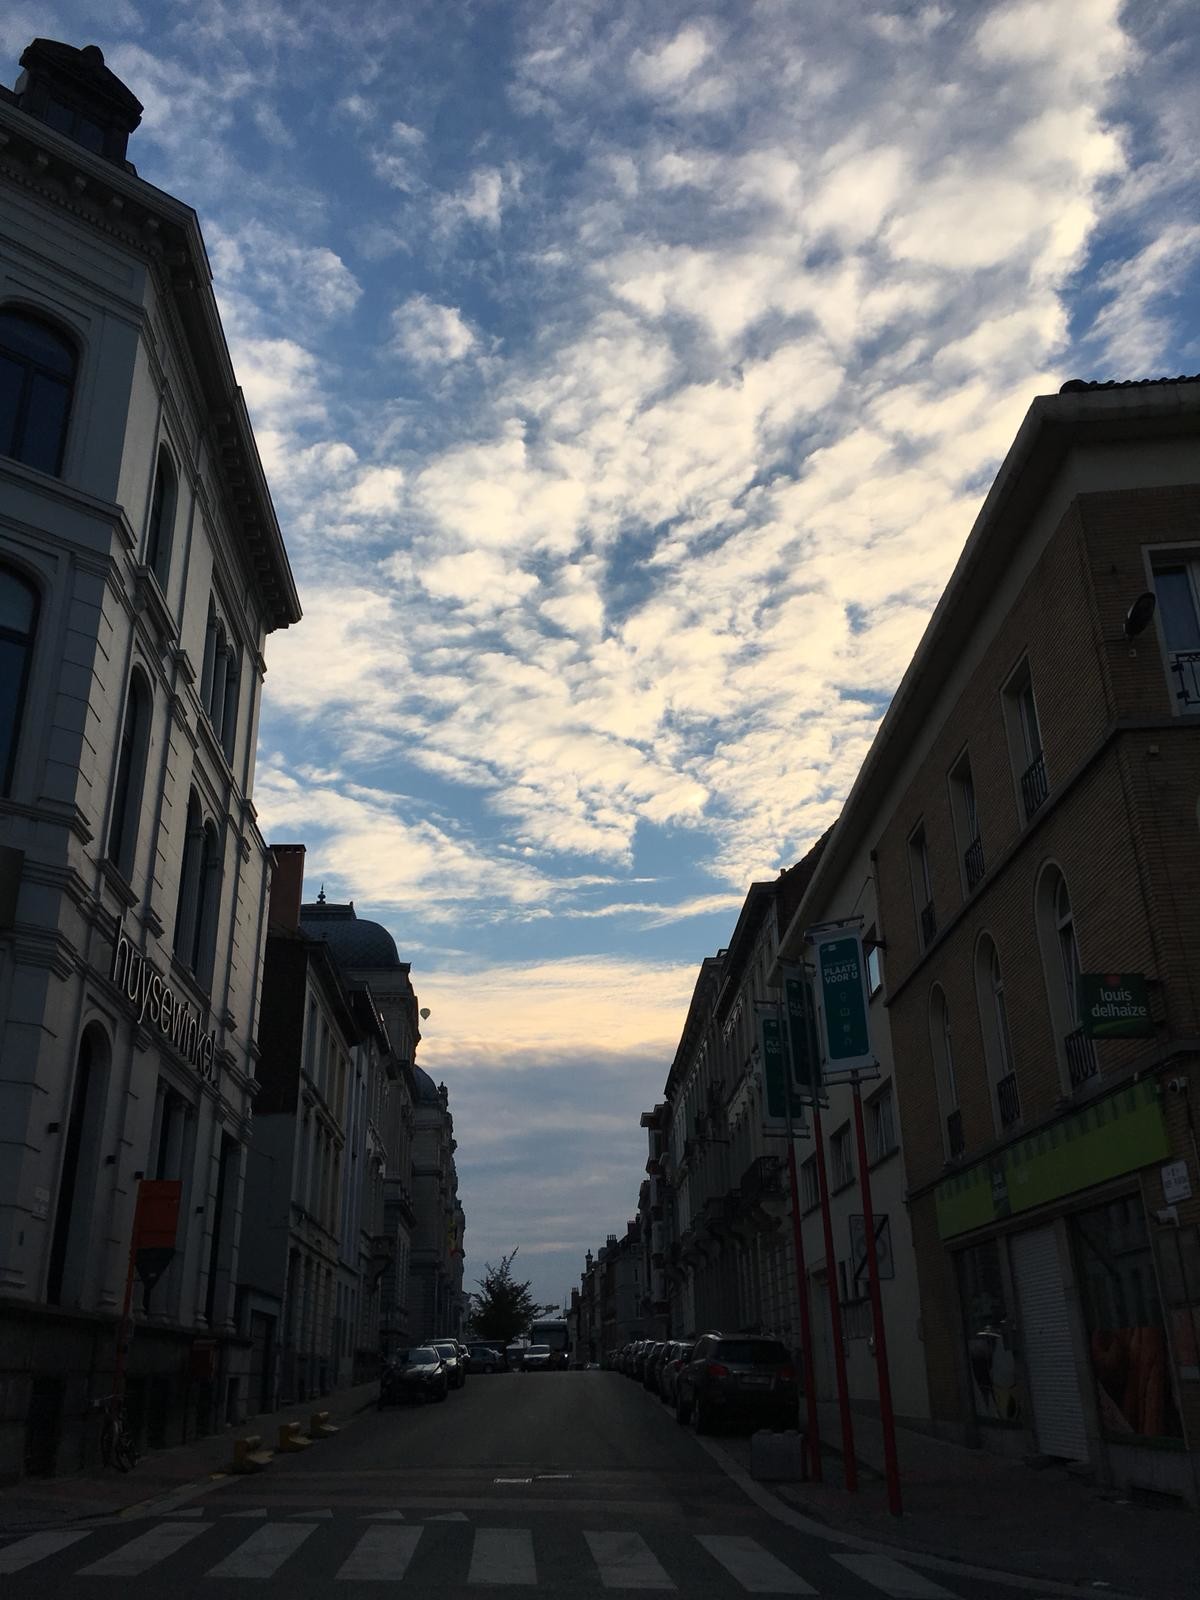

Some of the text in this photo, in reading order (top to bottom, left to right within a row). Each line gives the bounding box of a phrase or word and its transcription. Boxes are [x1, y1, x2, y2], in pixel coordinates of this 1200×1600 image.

[823, 962, 857, 977] PLAATS
[825, 971, 858, 984] VOOR U
[113, 915, 217, 1081] huysewinkel
[1099, 987, 1133, 1002] louis
[1091, 1003, 1148, 1017] delhaize
